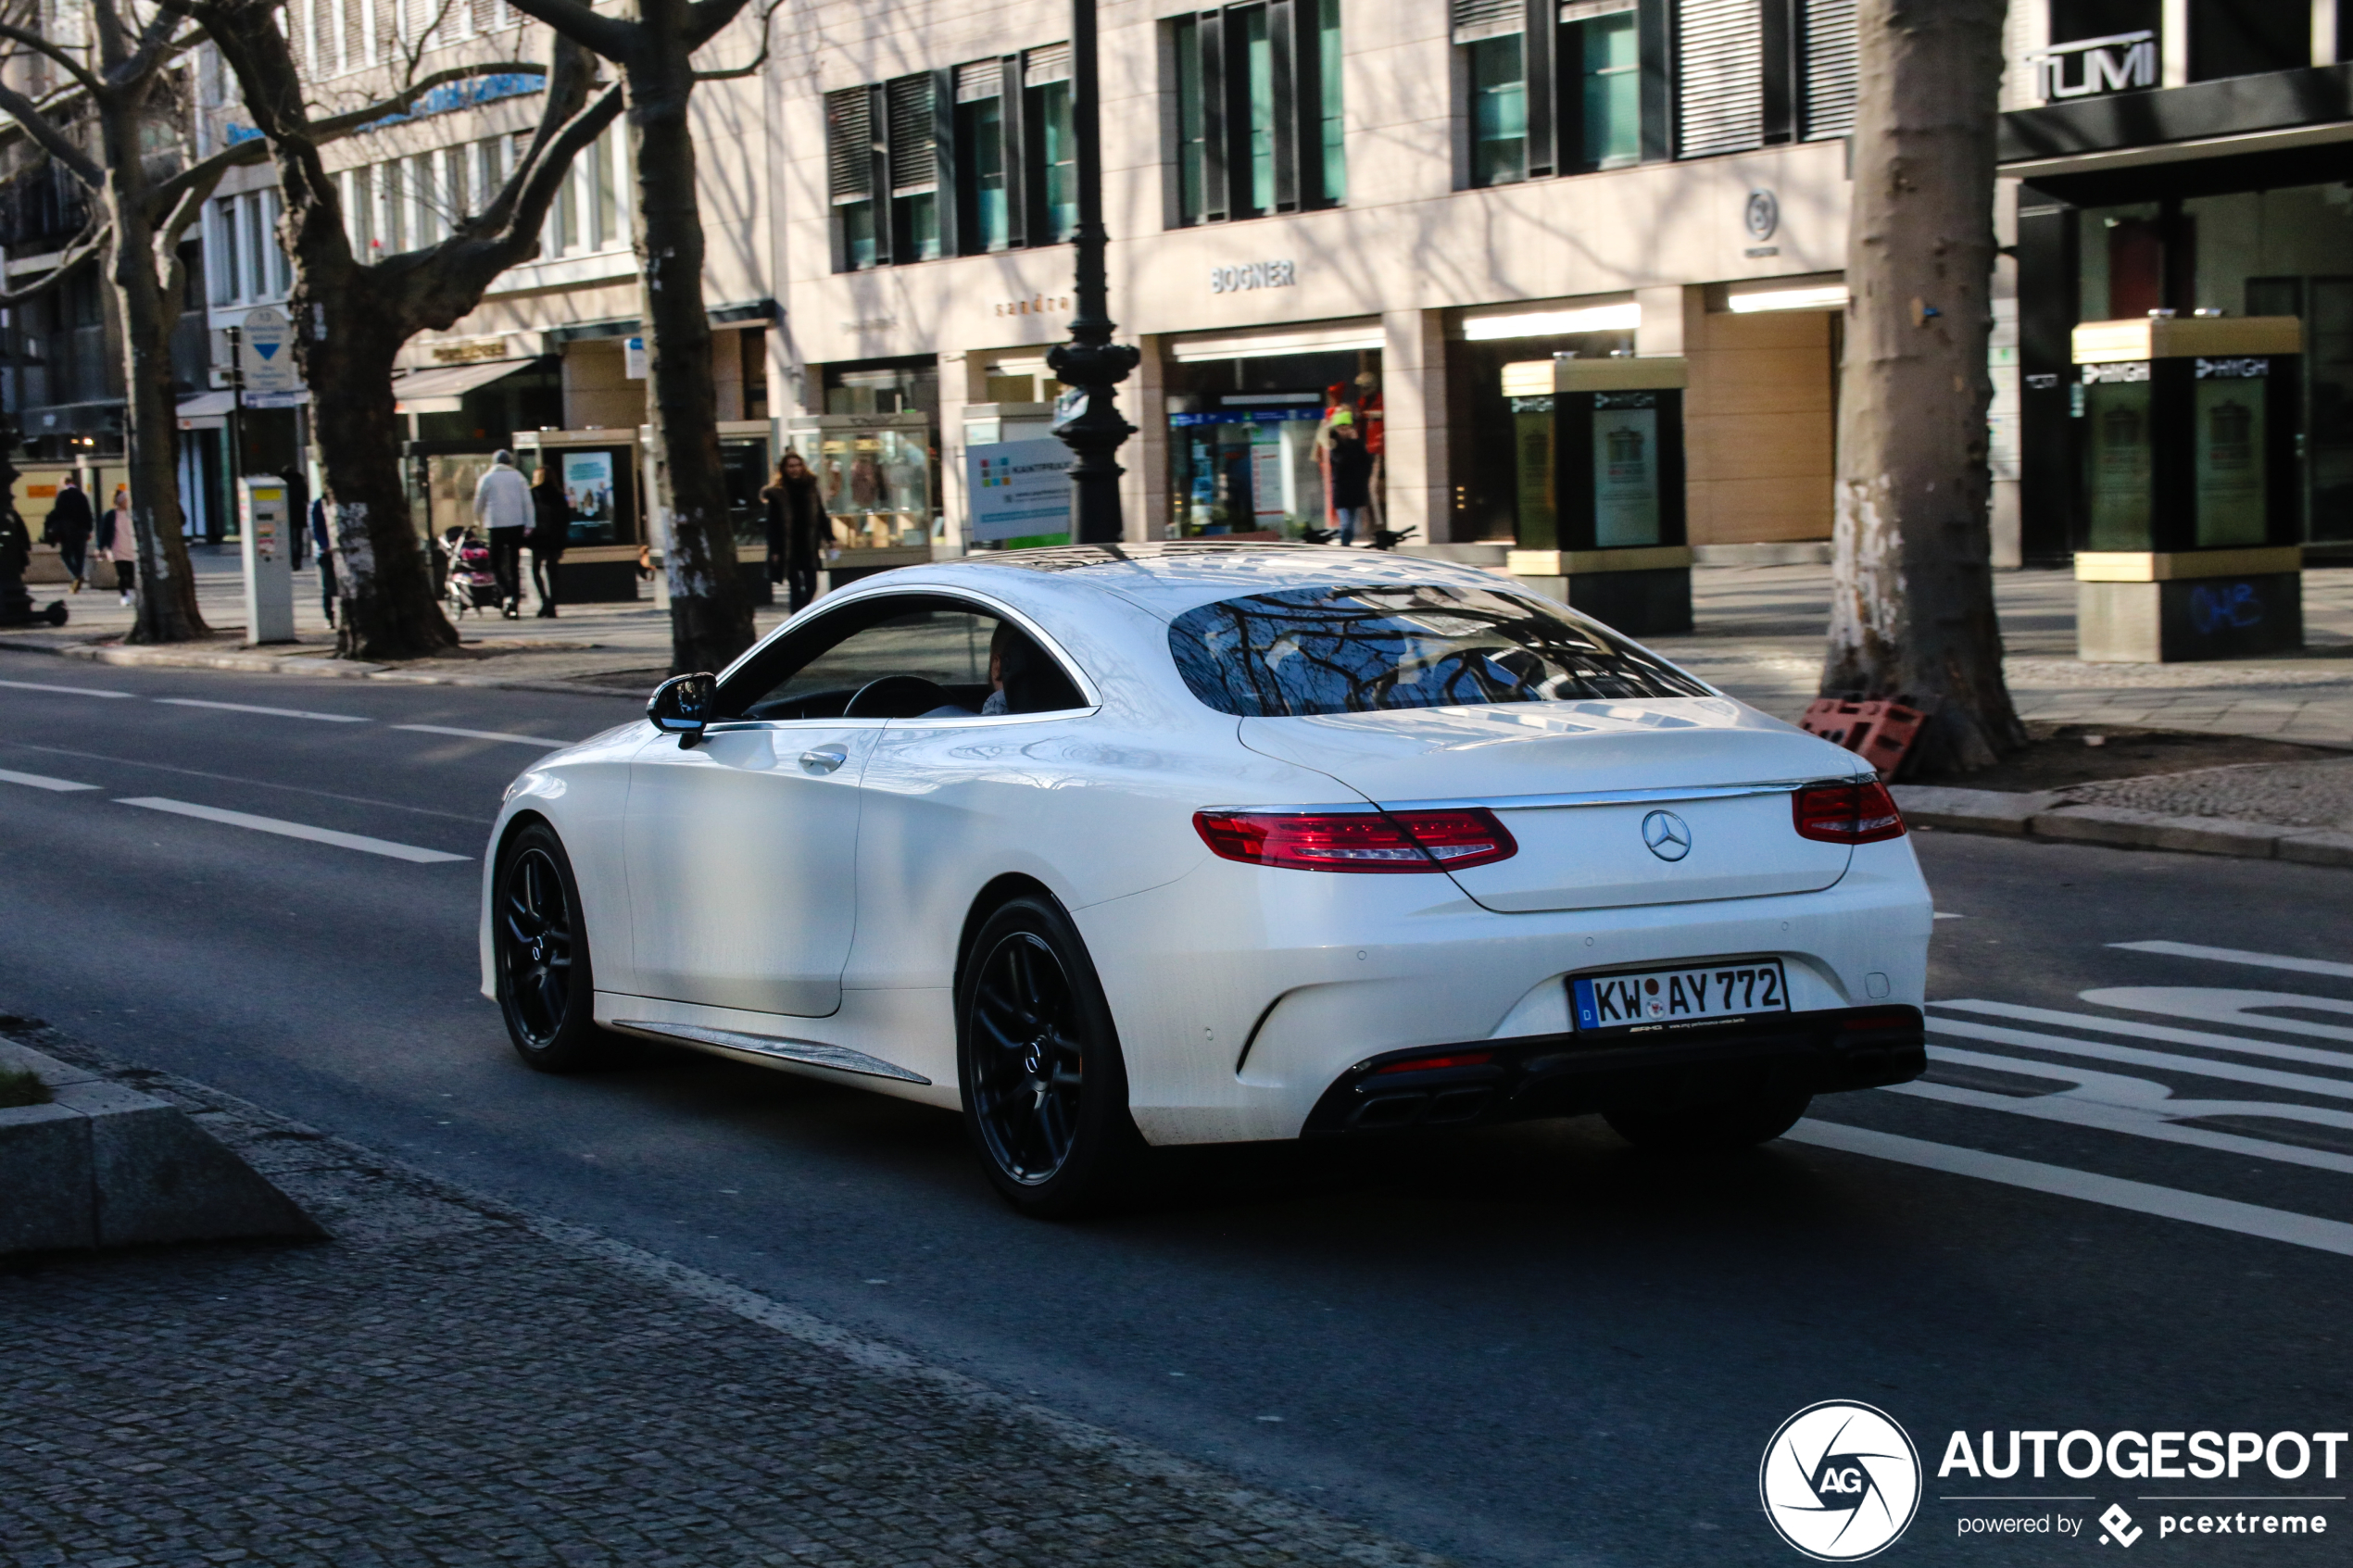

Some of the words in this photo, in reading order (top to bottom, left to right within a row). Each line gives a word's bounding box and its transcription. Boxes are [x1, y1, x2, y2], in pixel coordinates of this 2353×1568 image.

[2021, 29, 2155, 100] TUMI
[1211, 261, 1296, 294] BOGNER
[995, 293, 1069, 318] sandro
[1595, 980, 1642, 1021] KW
[1669, 973, 1706, 1015] AY
[1716, 968, 1780, 1010] 772
[1583, 1010, 1592, 1021] D
